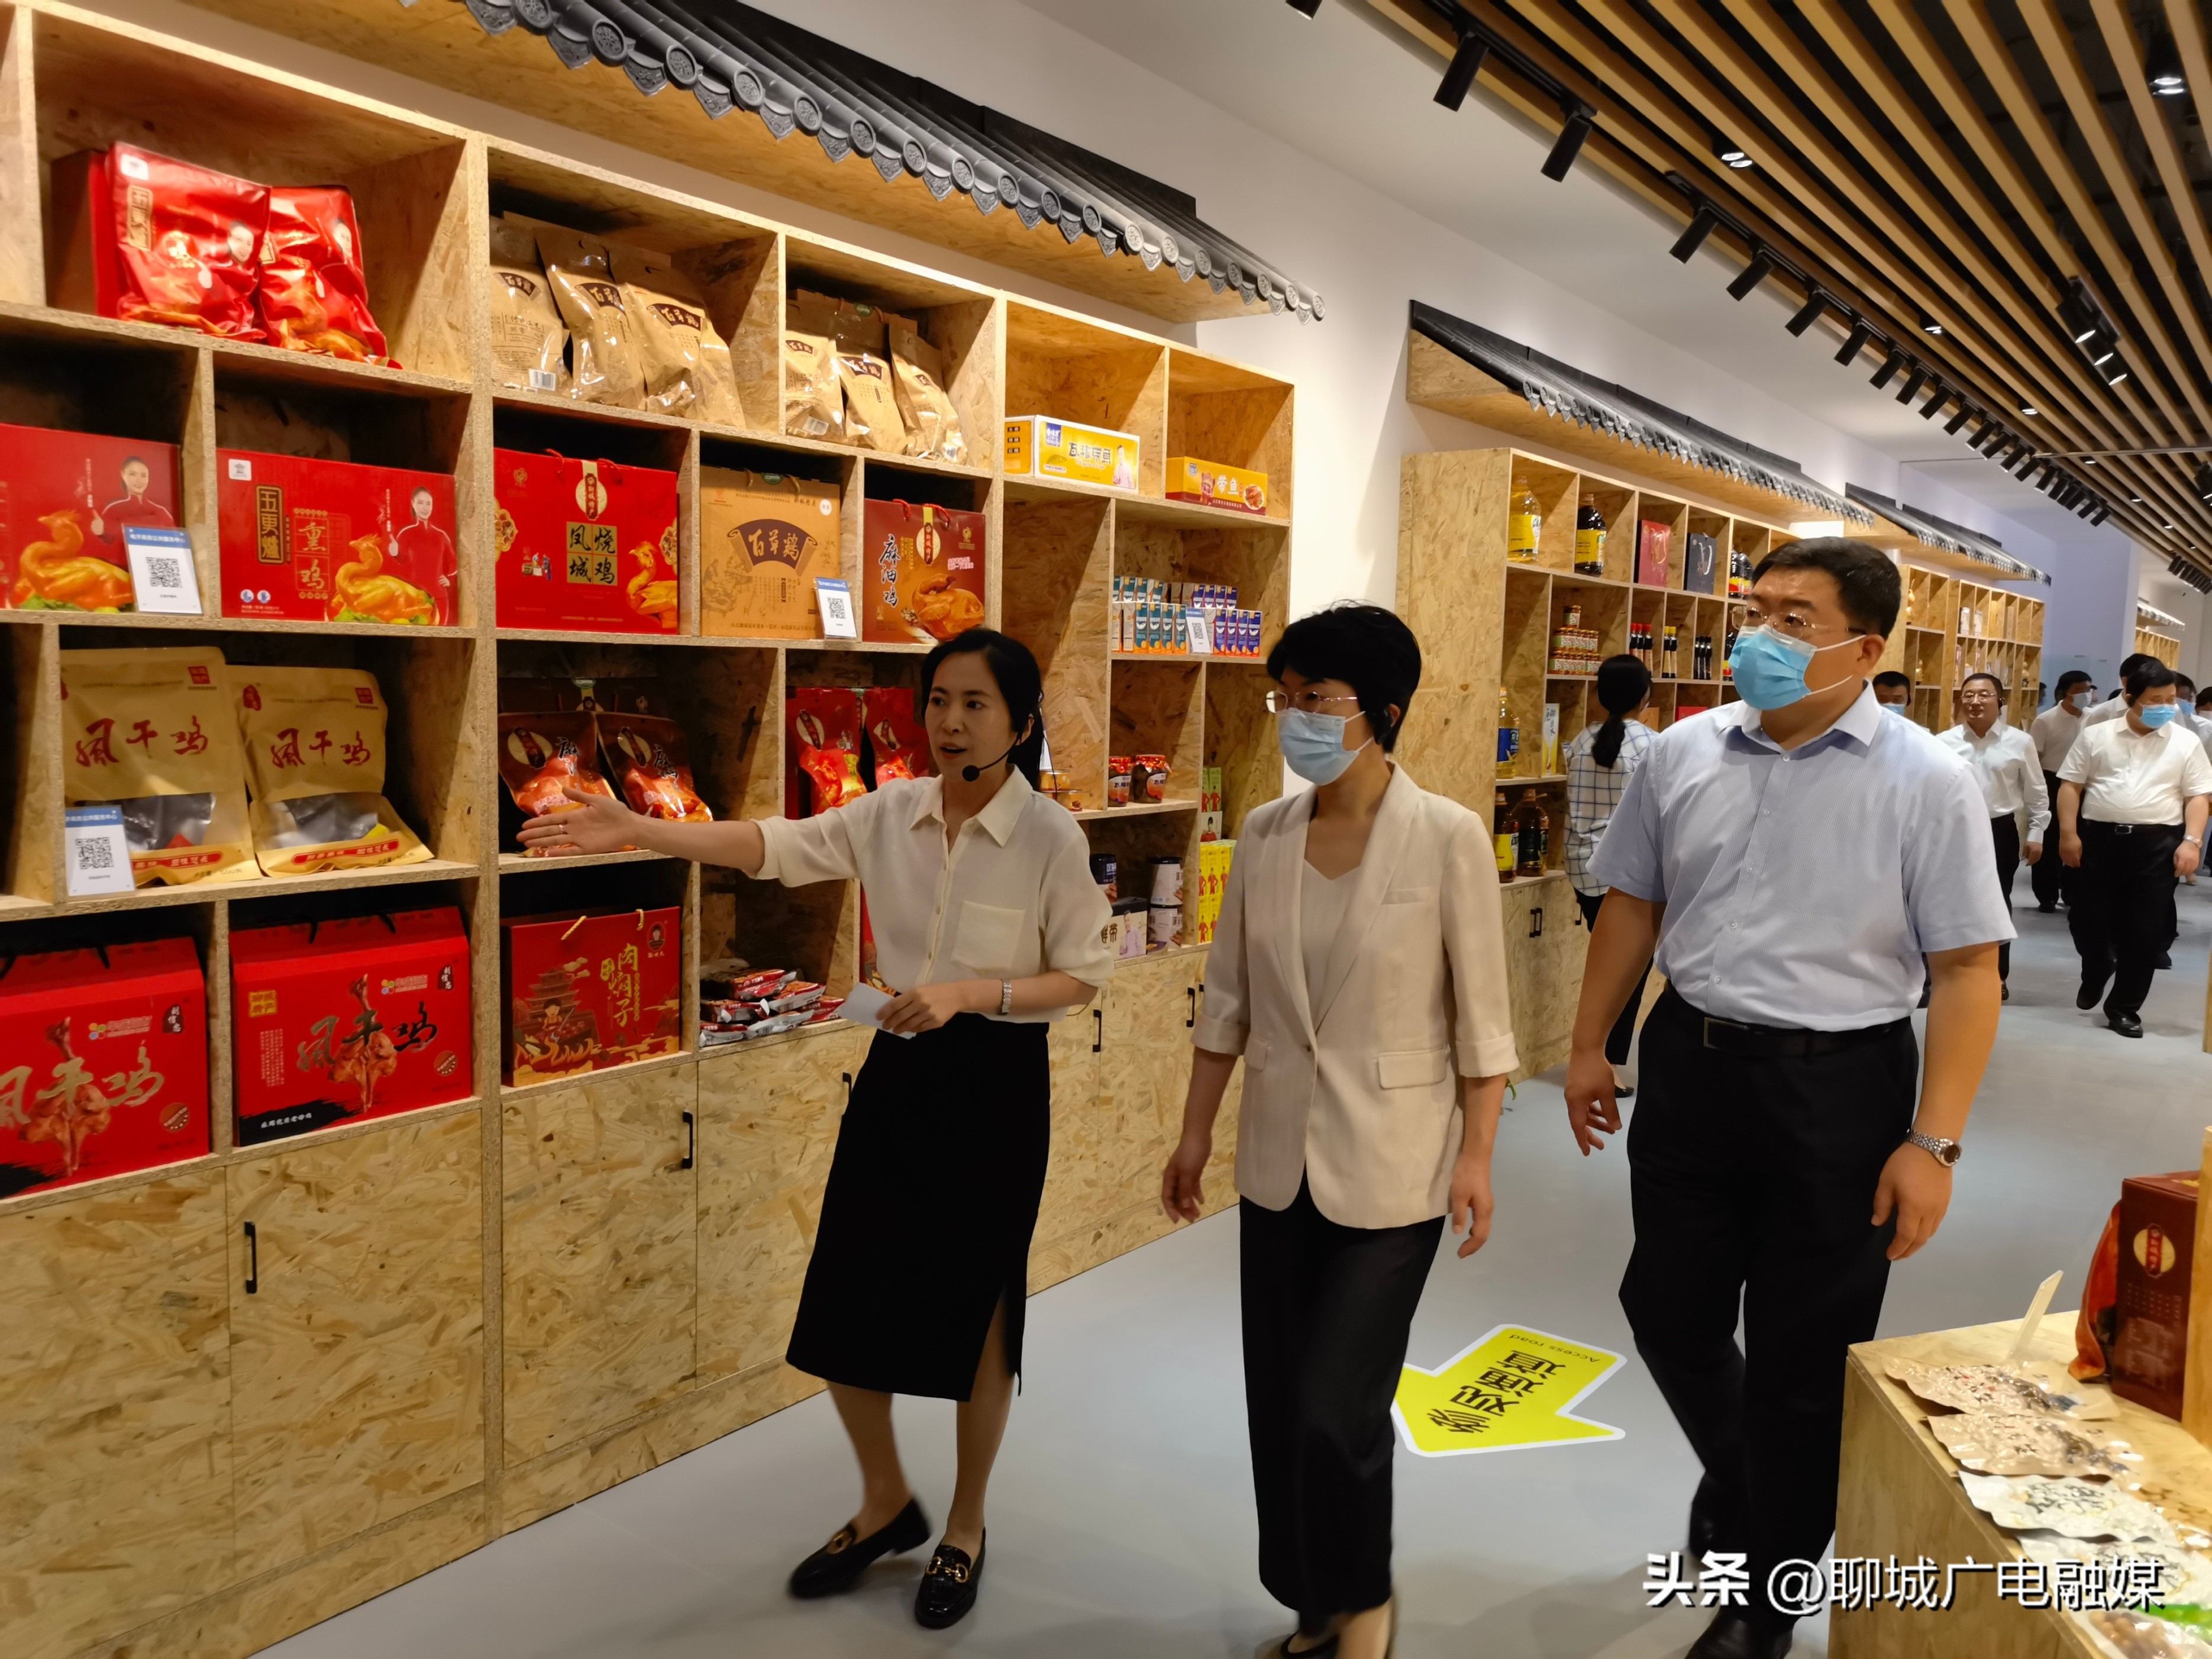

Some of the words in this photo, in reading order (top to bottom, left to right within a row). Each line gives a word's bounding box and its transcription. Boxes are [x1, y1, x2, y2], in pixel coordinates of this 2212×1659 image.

[1217, 475, 1239, 495] 带鱼
[298, 522, 327, 590] 熏鸡
[879, 533, 902, 608] 麻油鸡
[1509, 1333, 1545, 1348] road
[1548, 1344, 1601, 1364] Access
[1426, 1349, 1567, 1434] 参观通道
